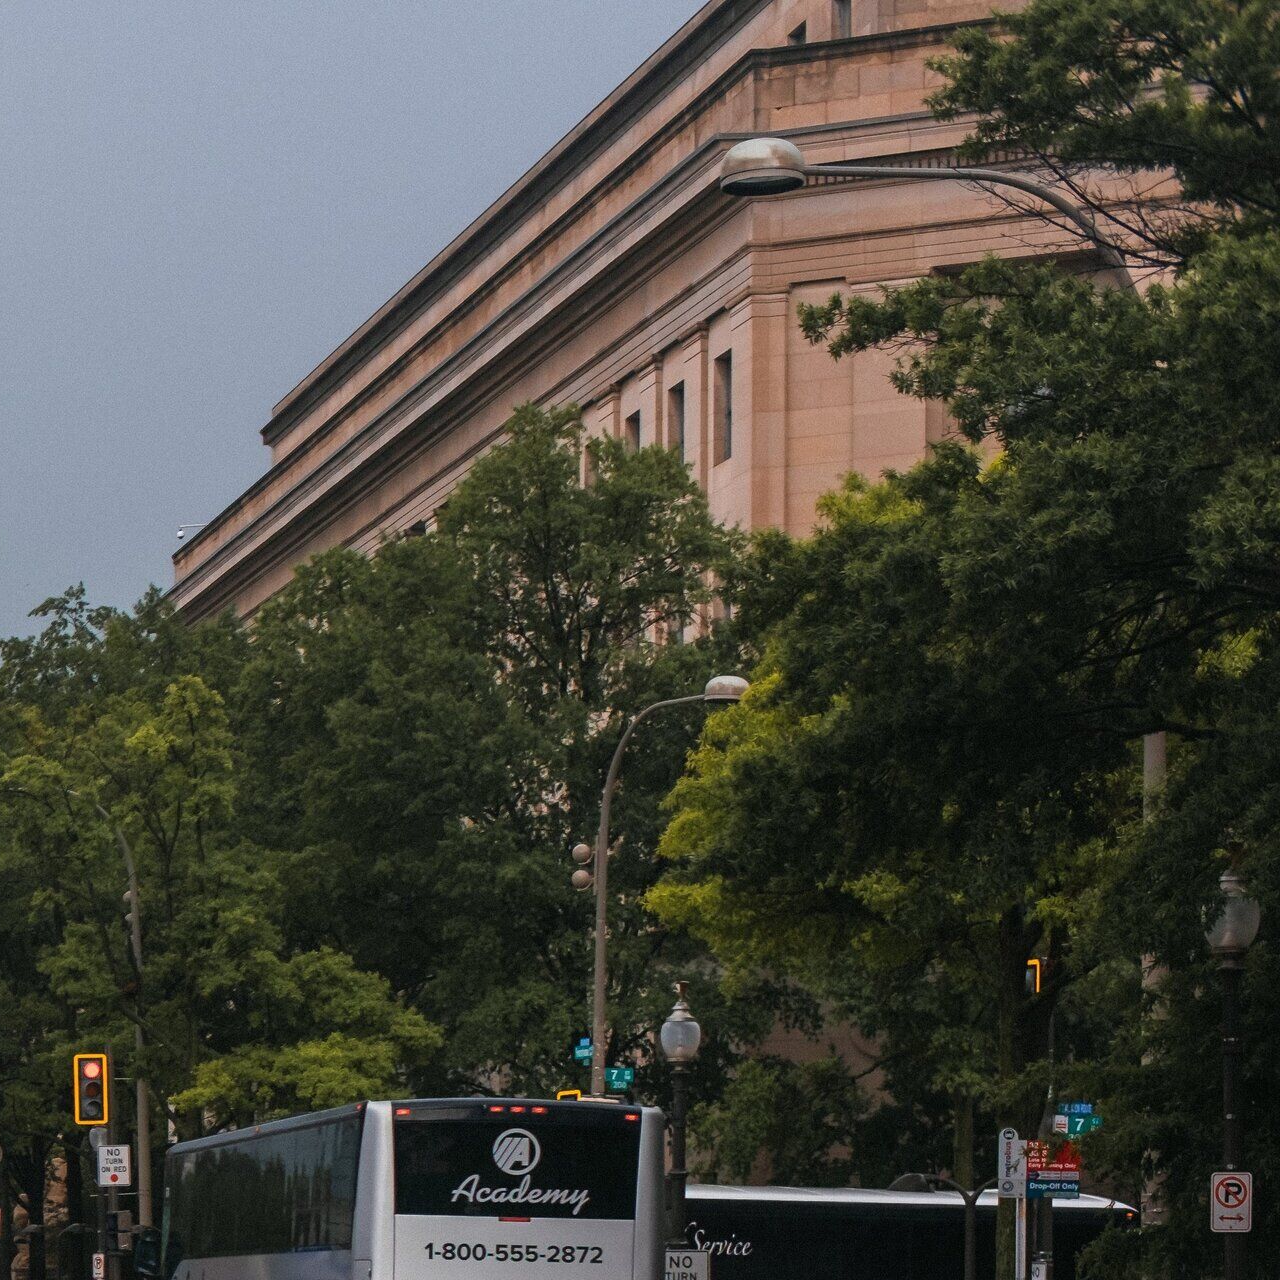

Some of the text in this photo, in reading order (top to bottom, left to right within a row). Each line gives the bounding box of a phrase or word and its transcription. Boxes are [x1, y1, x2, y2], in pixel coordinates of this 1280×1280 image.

[611, 1069, 618, 1080] 7
[1075, 1118, 1084, 1131] 7
[106, 1148, 121, 1157] NO
[105, 1157, 123, 1165] TURN
[113, 1165, 127, 1173] RED
[1029, 1182, 1079, 1191] Drop-Off Only
[450, 1174, 590, 1216] Academy
[694, 1229, 753, 1256] Service
[424, 1241, 604, 1264] 1-800-555-2872
[669, 1255, 693, 1269] NO
